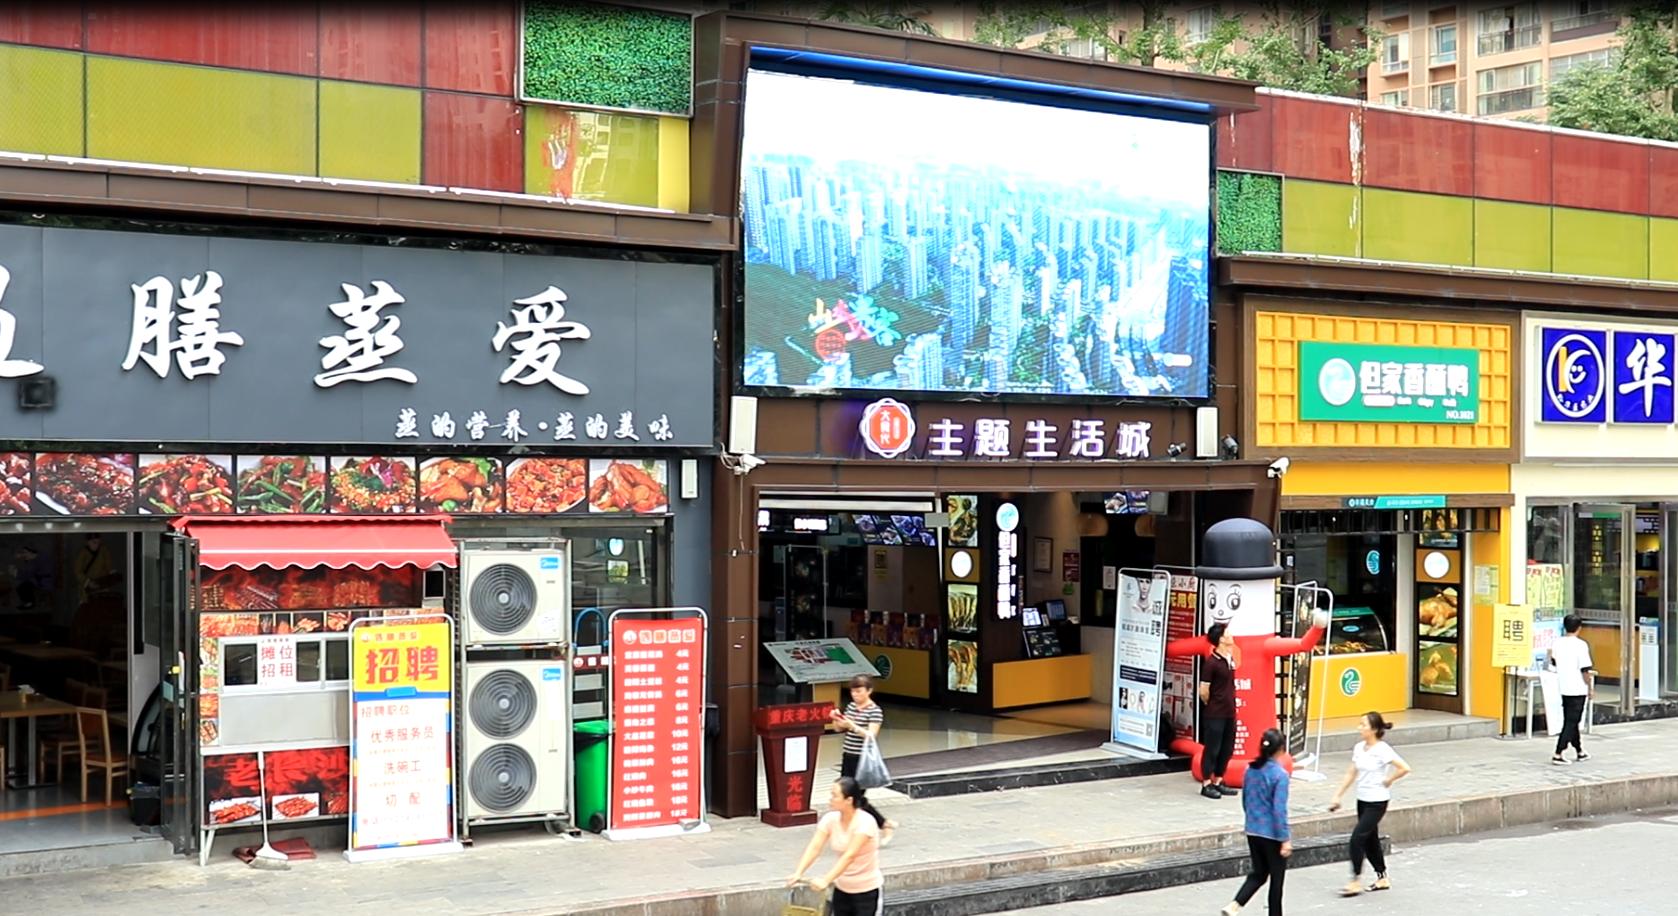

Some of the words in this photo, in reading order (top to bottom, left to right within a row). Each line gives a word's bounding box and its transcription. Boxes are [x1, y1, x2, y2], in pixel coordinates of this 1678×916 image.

[1619, 338, 1673, 418] 华
[394, 408, 675, 443] 蒸的营养·蒸的美味
[928, 418, 1152, 458] 主题生活城
[261, 663, 293, 678] 招租
[366, 646, 439, 684] 招聘
[361, 705, 410, 719] 招聘职位
[371, 726, 434, 743] 优秀服务员
[384, 760, 421, 775] 洗碗工
[786, 776, 803, 812] 光临
